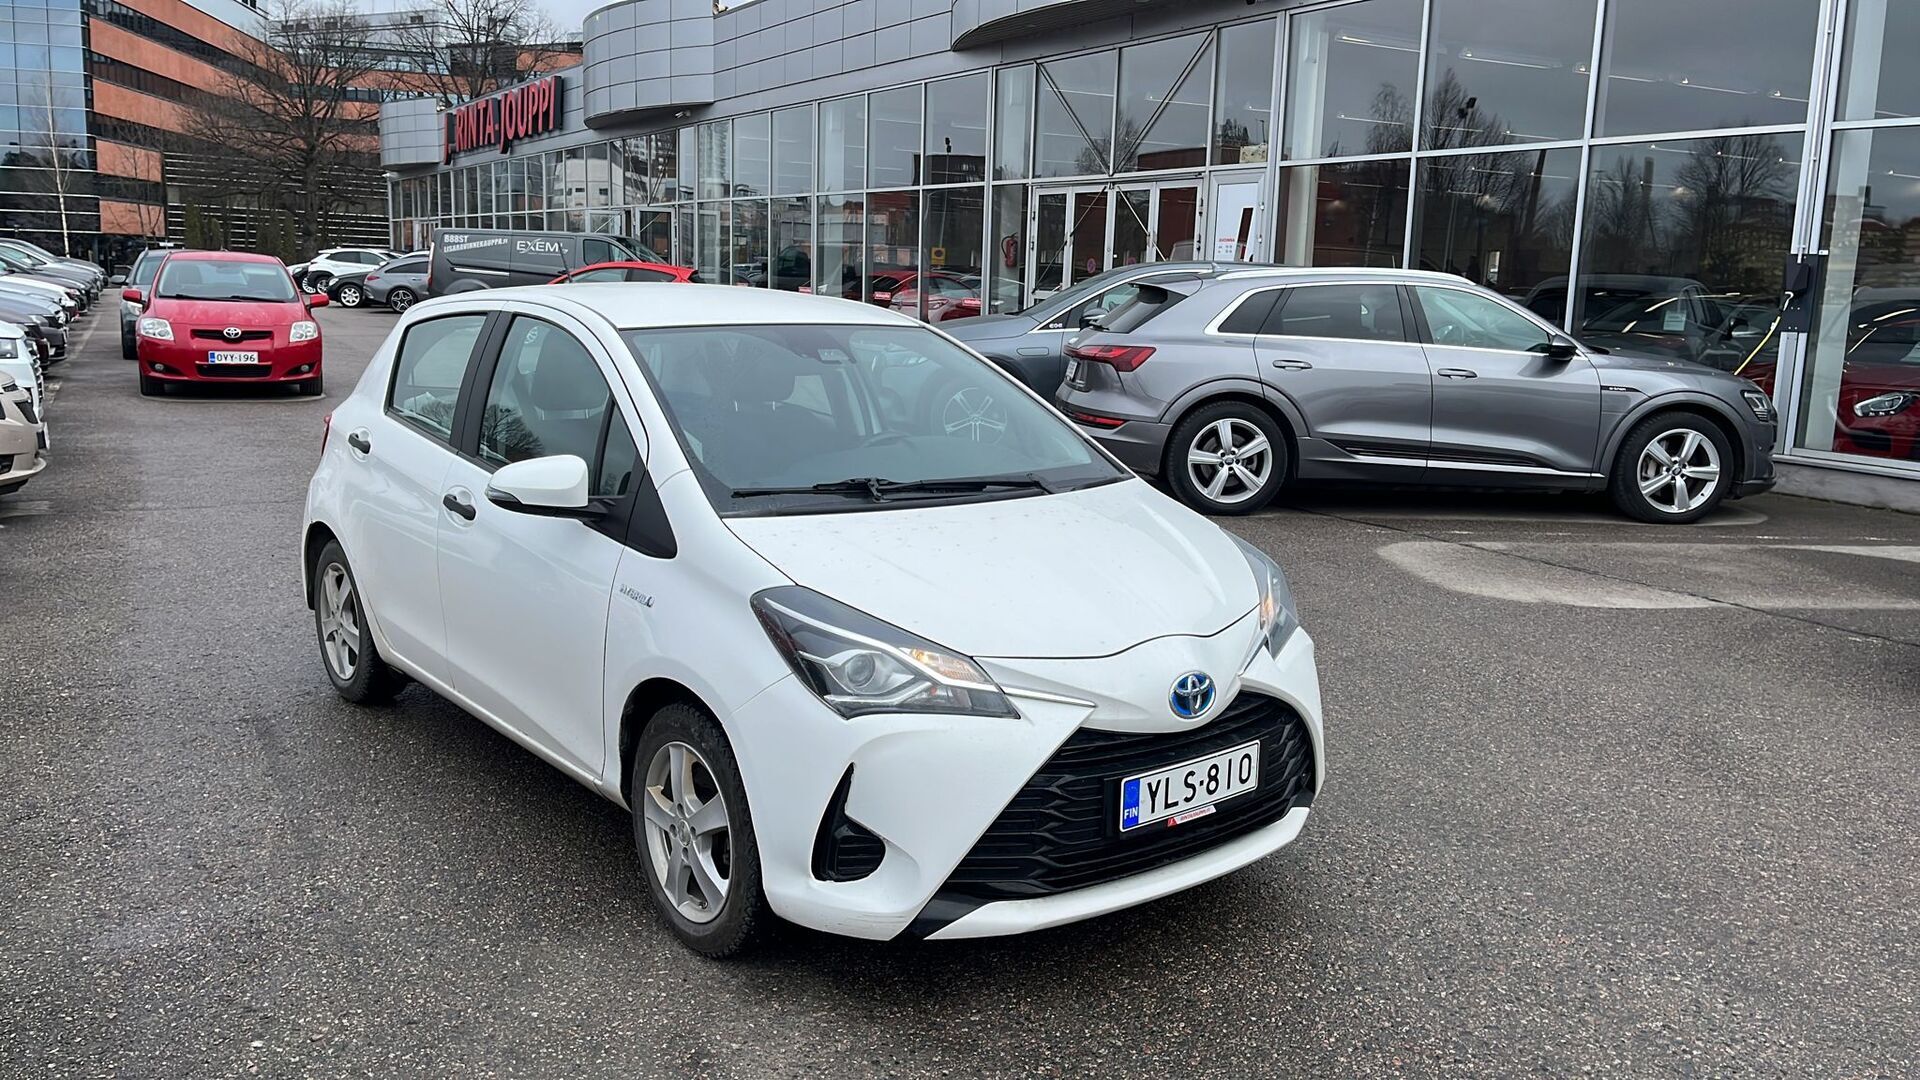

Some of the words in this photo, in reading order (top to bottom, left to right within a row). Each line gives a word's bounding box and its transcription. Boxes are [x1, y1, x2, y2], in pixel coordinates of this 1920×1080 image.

[216, 353, 256, 363] OVY-196
[1124, 806, 1139, 820] FIN
[1147, 753, 1253, 814] YLS-810
